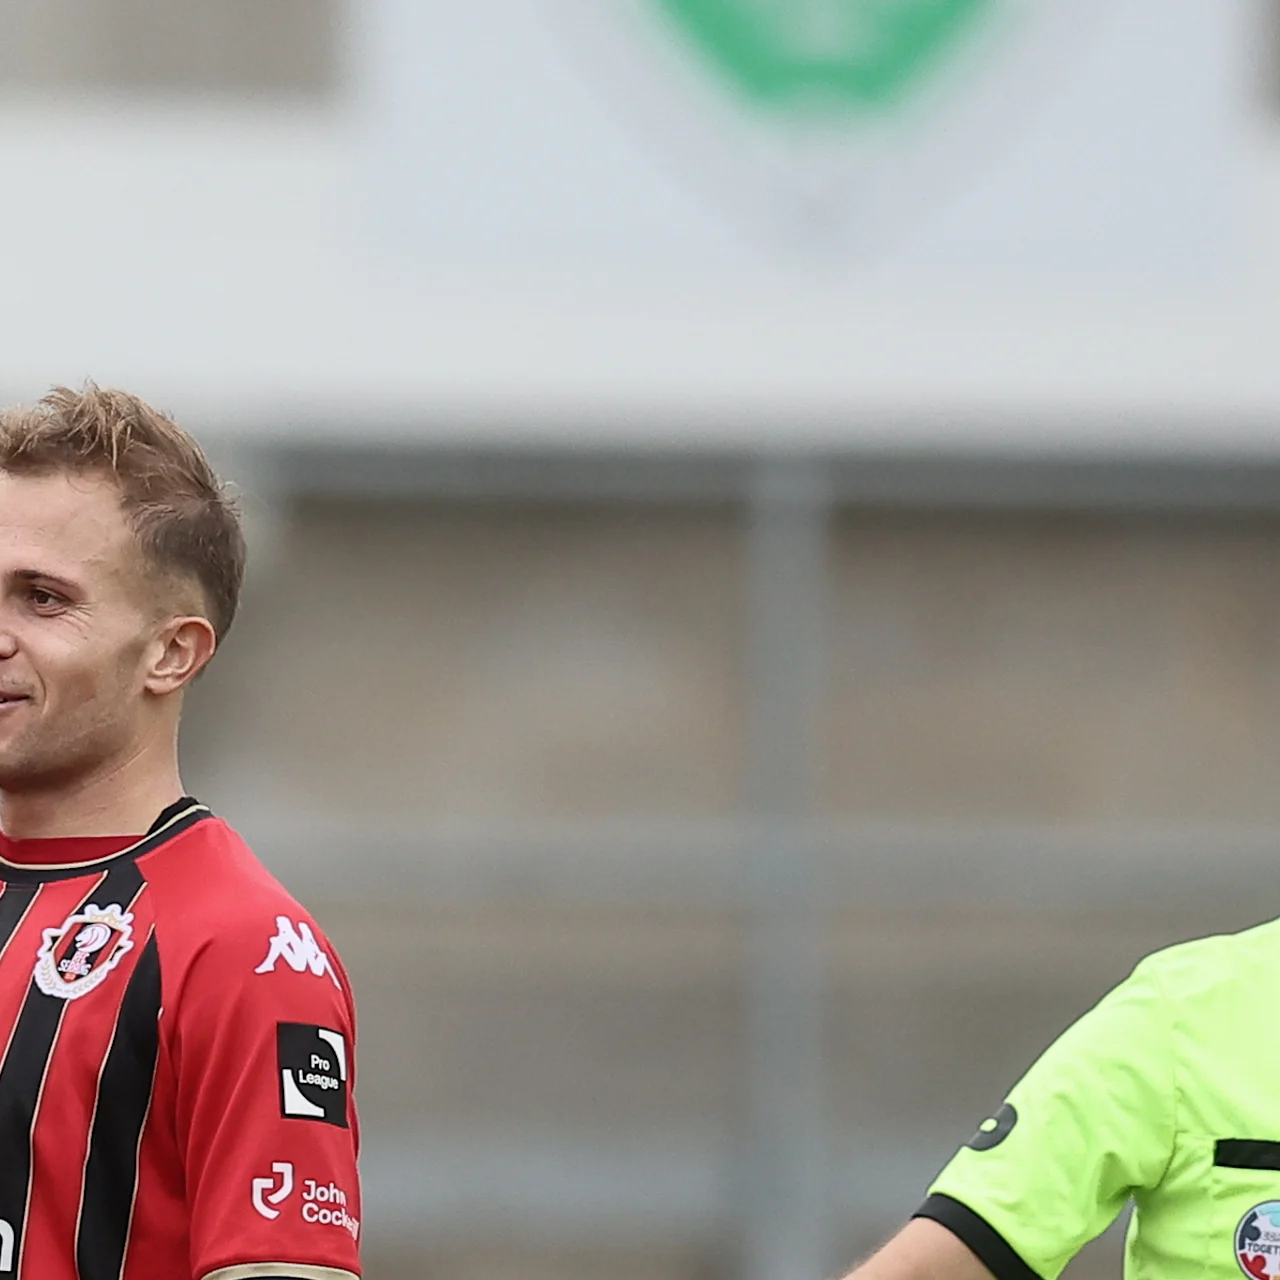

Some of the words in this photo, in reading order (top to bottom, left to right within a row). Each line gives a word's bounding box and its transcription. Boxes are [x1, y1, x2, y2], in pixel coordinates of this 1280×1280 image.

[310, 1054, 331, 1072] Pro
[298, 1069, 340, 1090] League
[301, 1180, 348, 1207] John
